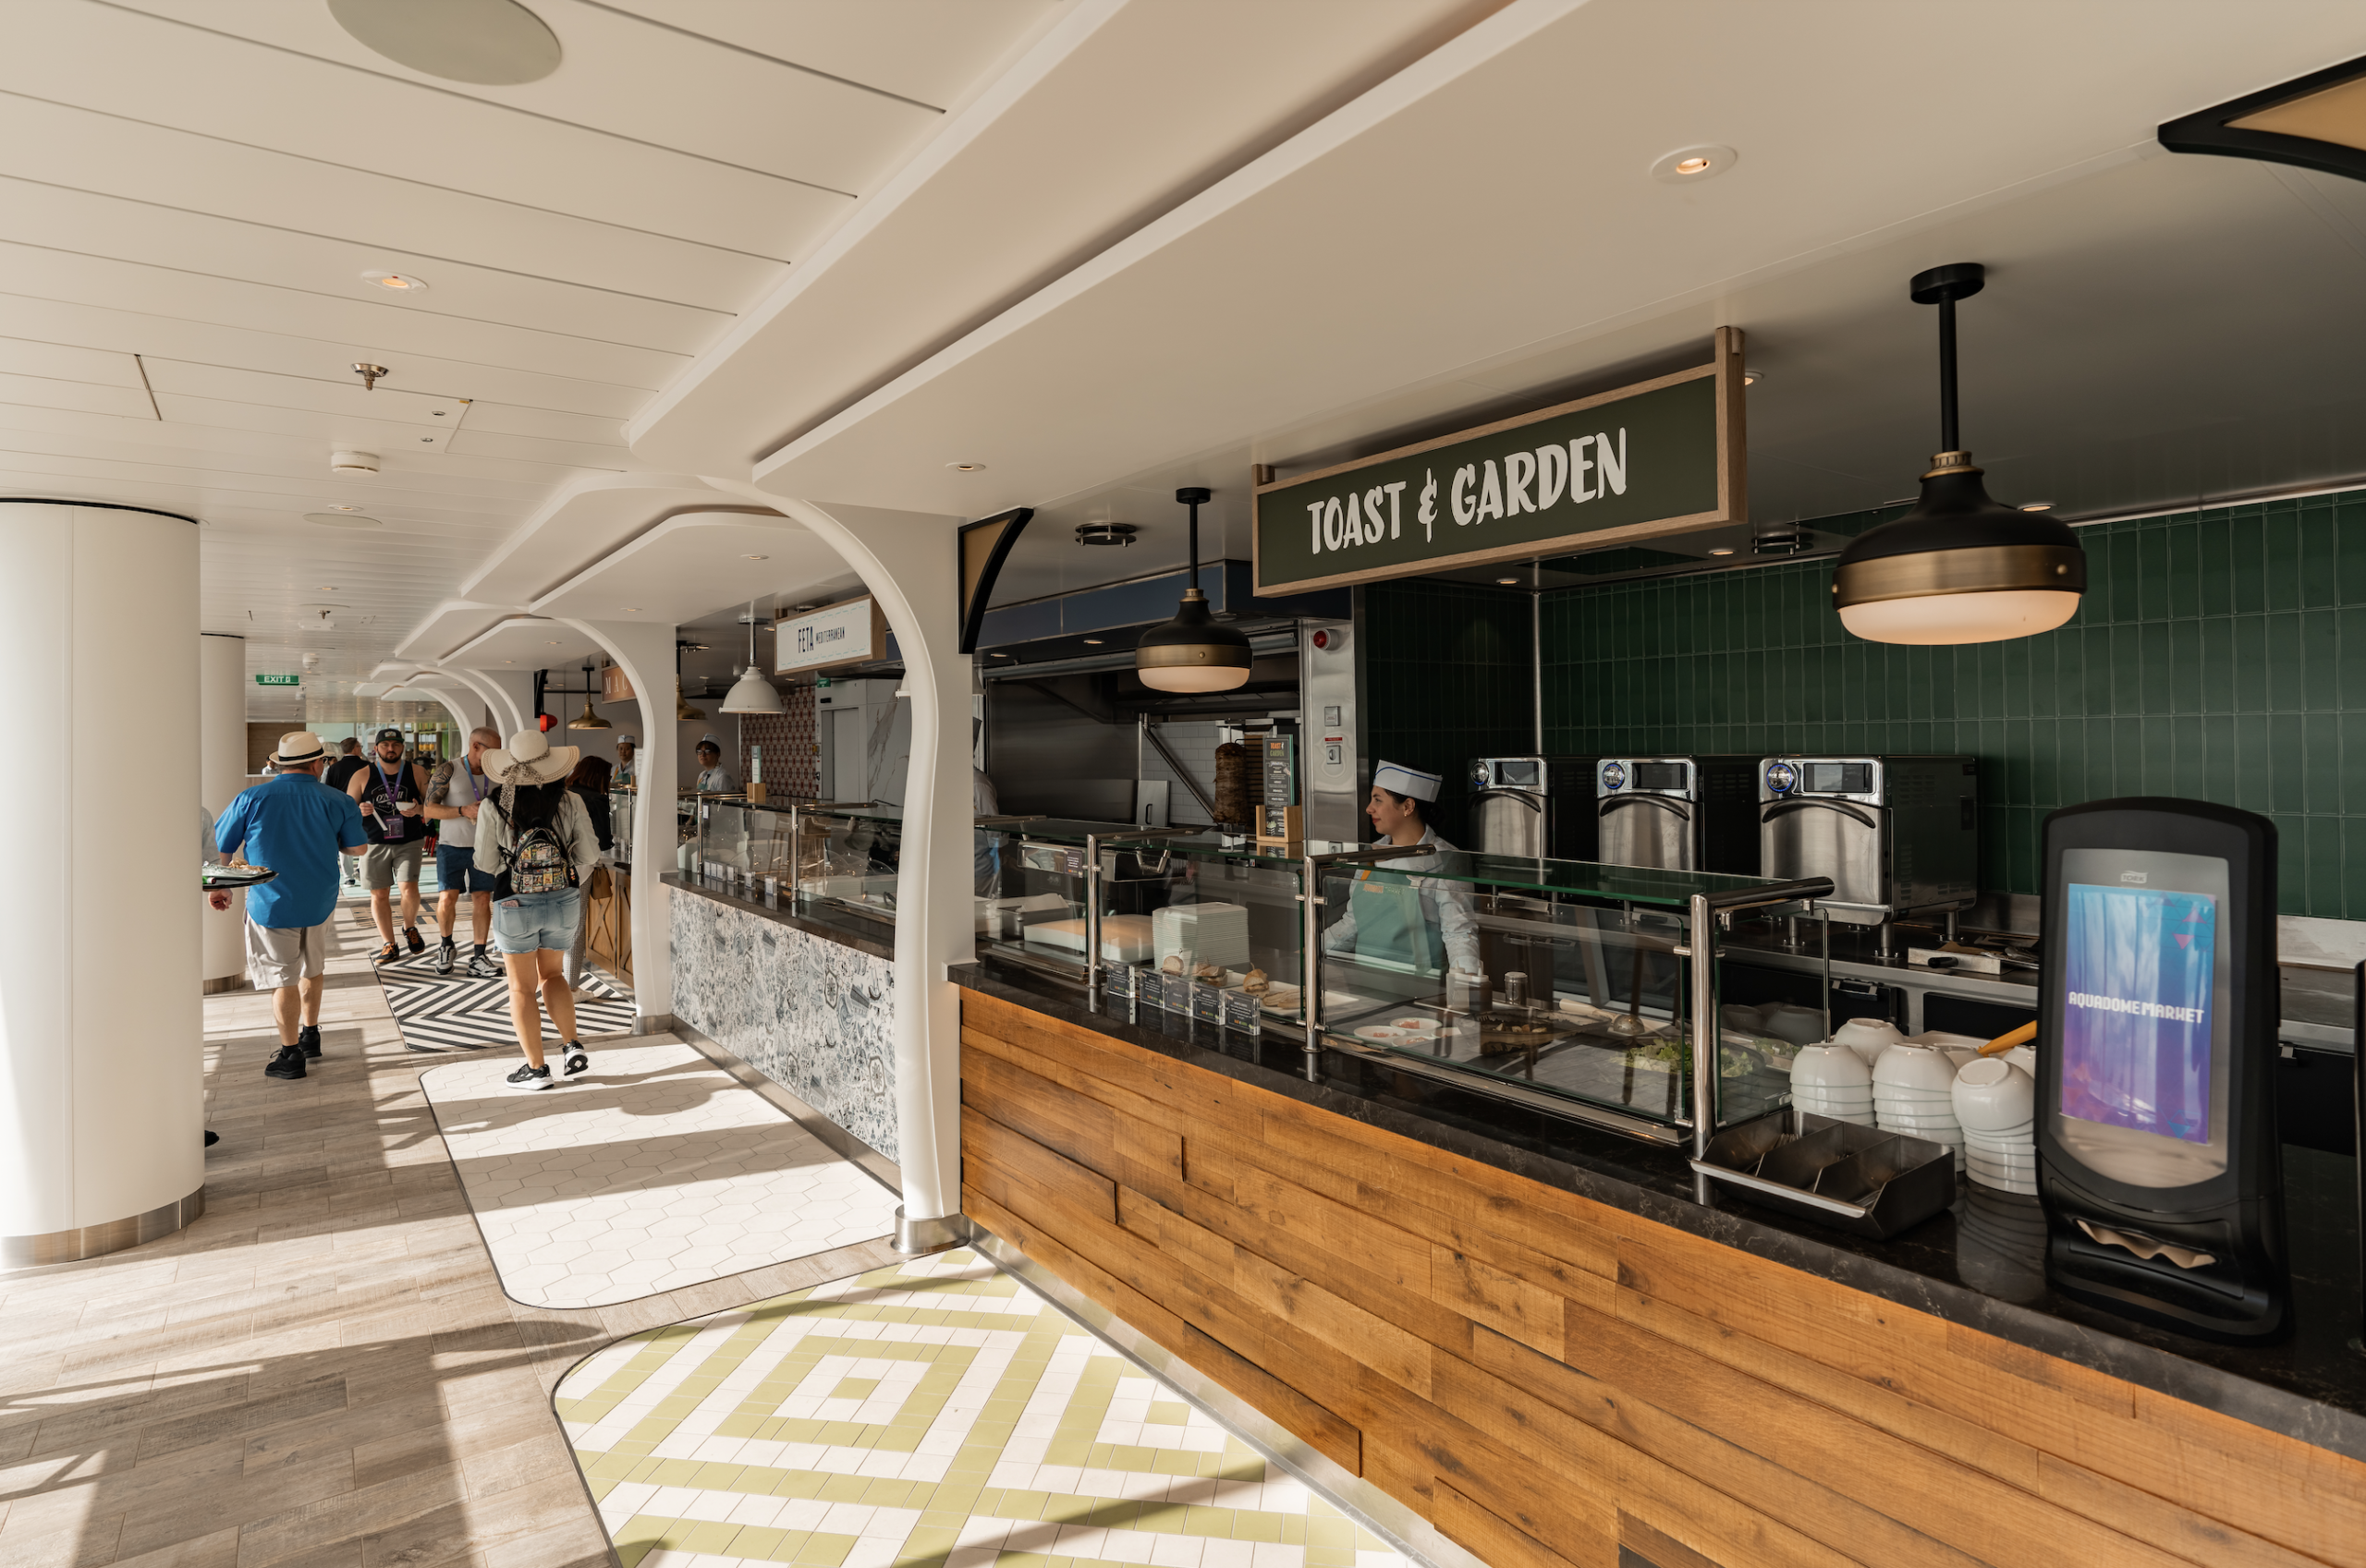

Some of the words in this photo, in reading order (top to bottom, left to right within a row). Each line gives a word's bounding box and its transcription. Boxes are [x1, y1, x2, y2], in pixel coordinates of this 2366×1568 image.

[1306, 480, 1407, 554] TOAST
[1417, 468, 1438, 543] &
[1450, 427, 1628, 527] GARDEN
[798, 626, 814, 653] FETA
[815, 626, 845, 645] MEDITERRANEAN
[2122, 873, 2146, 882] TORK
[2068, 991, 2140, 1015] AQUADOME
[2141, 1002, 2204, 1024] MARKET
